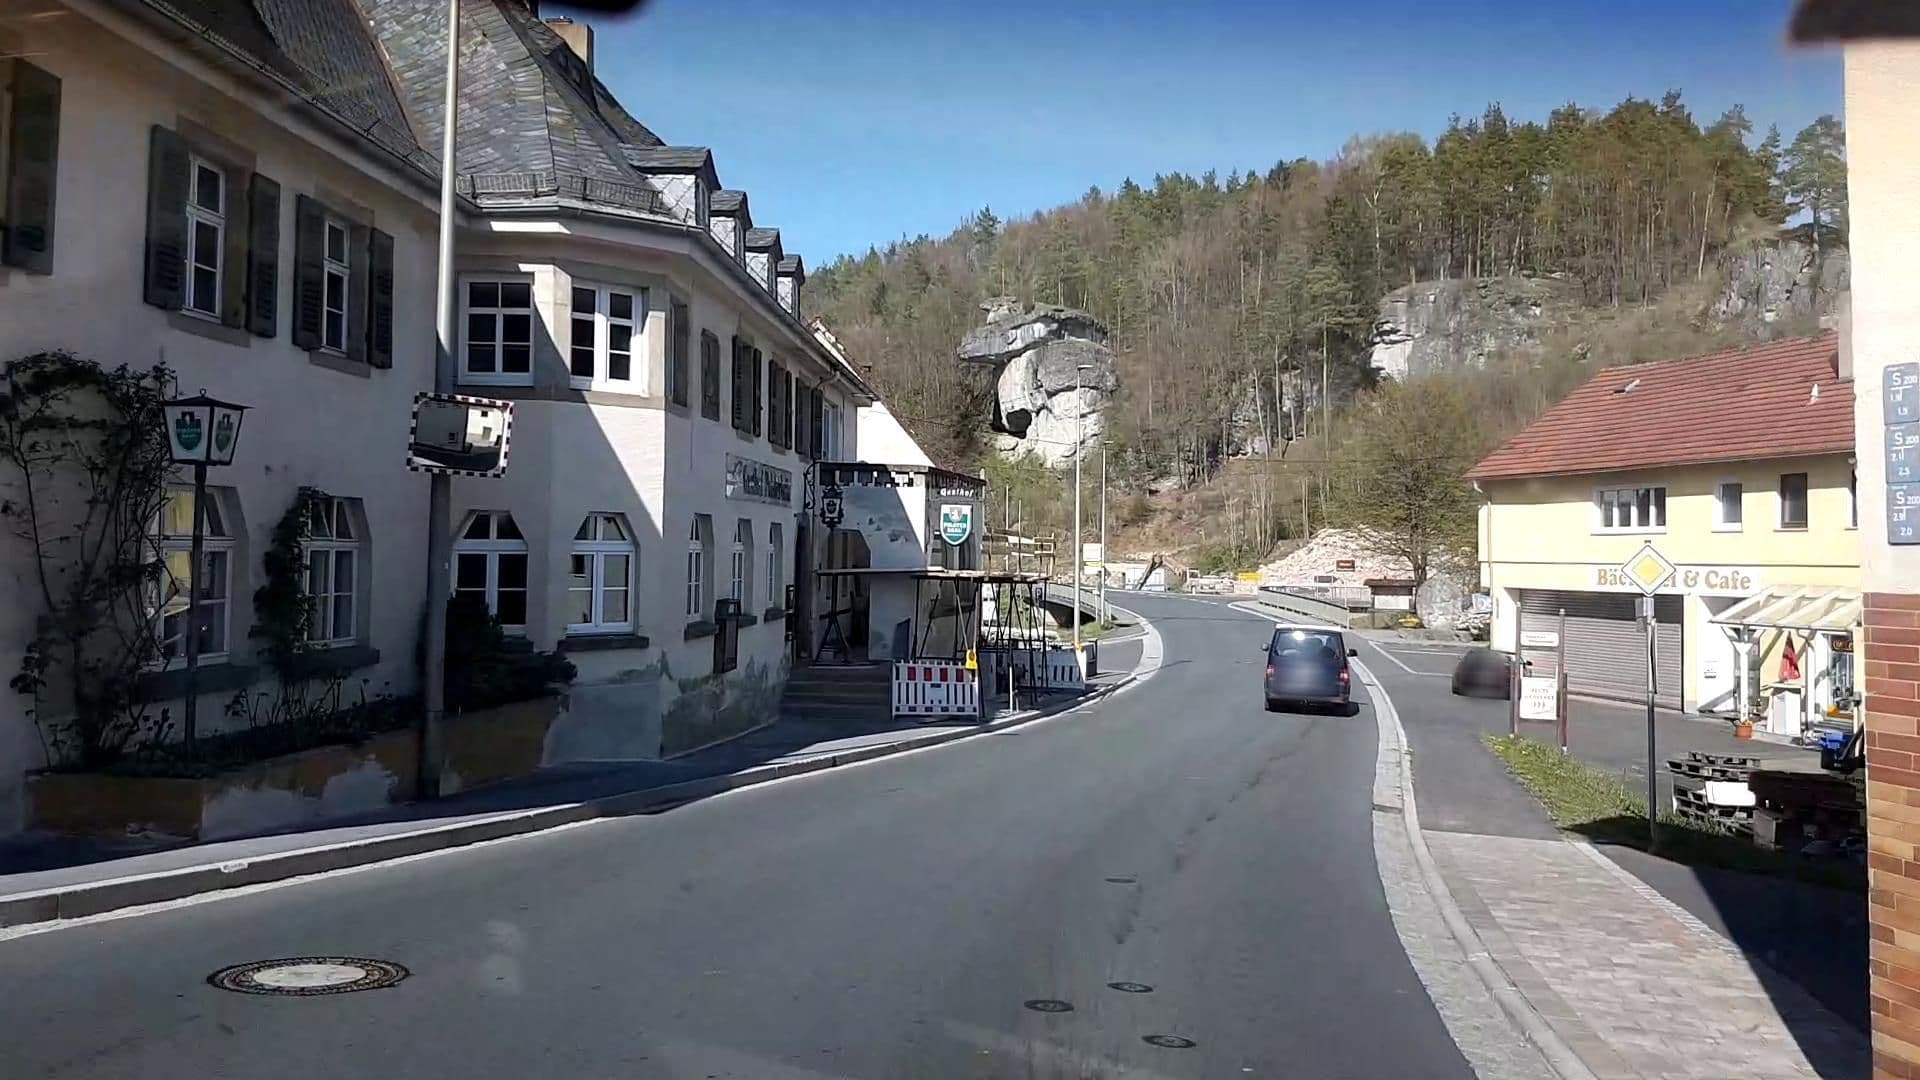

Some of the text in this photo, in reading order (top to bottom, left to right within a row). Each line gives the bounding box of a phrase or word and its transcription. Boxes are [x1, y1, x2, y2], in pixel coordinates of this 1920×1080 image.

[1892, 372, 1918, 385] S 200
[1894, 431, 1920, 445] S 200
[940, 488, 975, 498] Gasthof
[1895, 490, 1920, 505] S 200
[1596, 568, 1751, 591] Bäcei & Cafe
